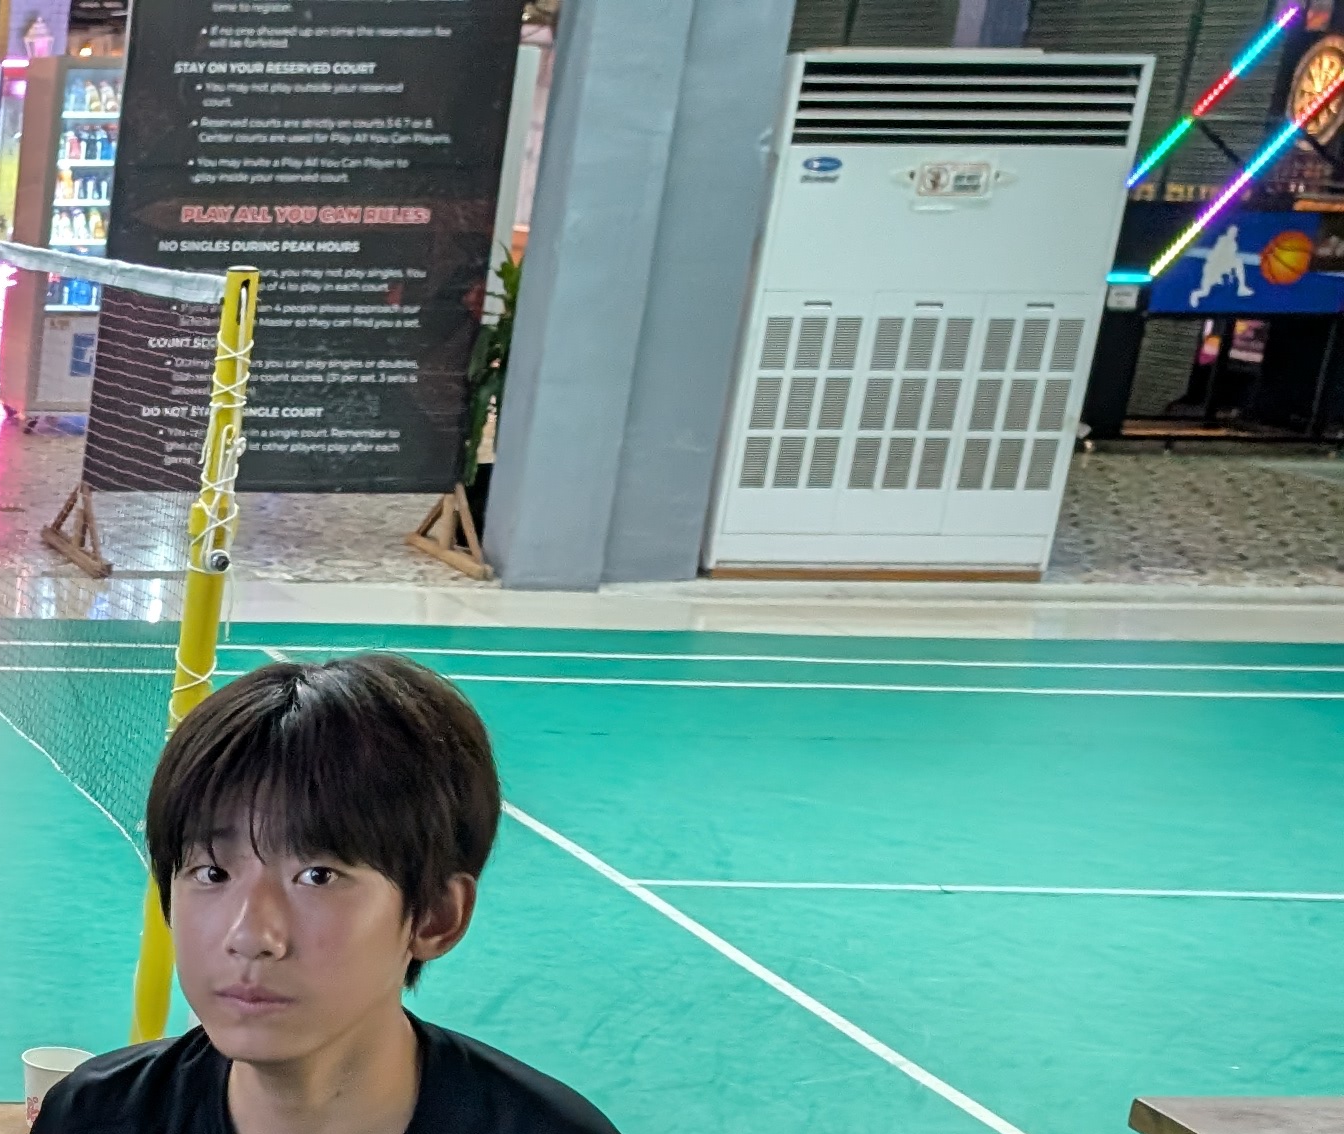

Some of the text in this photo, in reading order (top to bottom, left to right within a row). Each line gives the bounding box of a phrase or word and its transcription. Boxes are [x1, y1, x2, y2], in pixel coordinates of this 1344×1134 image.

[174, 61, 377, 74] STAY ON YOUR RESERVED COURT
[181, 206, 234, 223] PLAY
[233, 206, 273, 223] ALL
[274, 206, 318, 224] YOU
[318, 206, 362, 224] CAN
[158, 240, 360, 252] NO SINGLES DURING PEAK HOURS
[142, 406, 160, 417] DO
[281, 408, 324, 418] COURT
